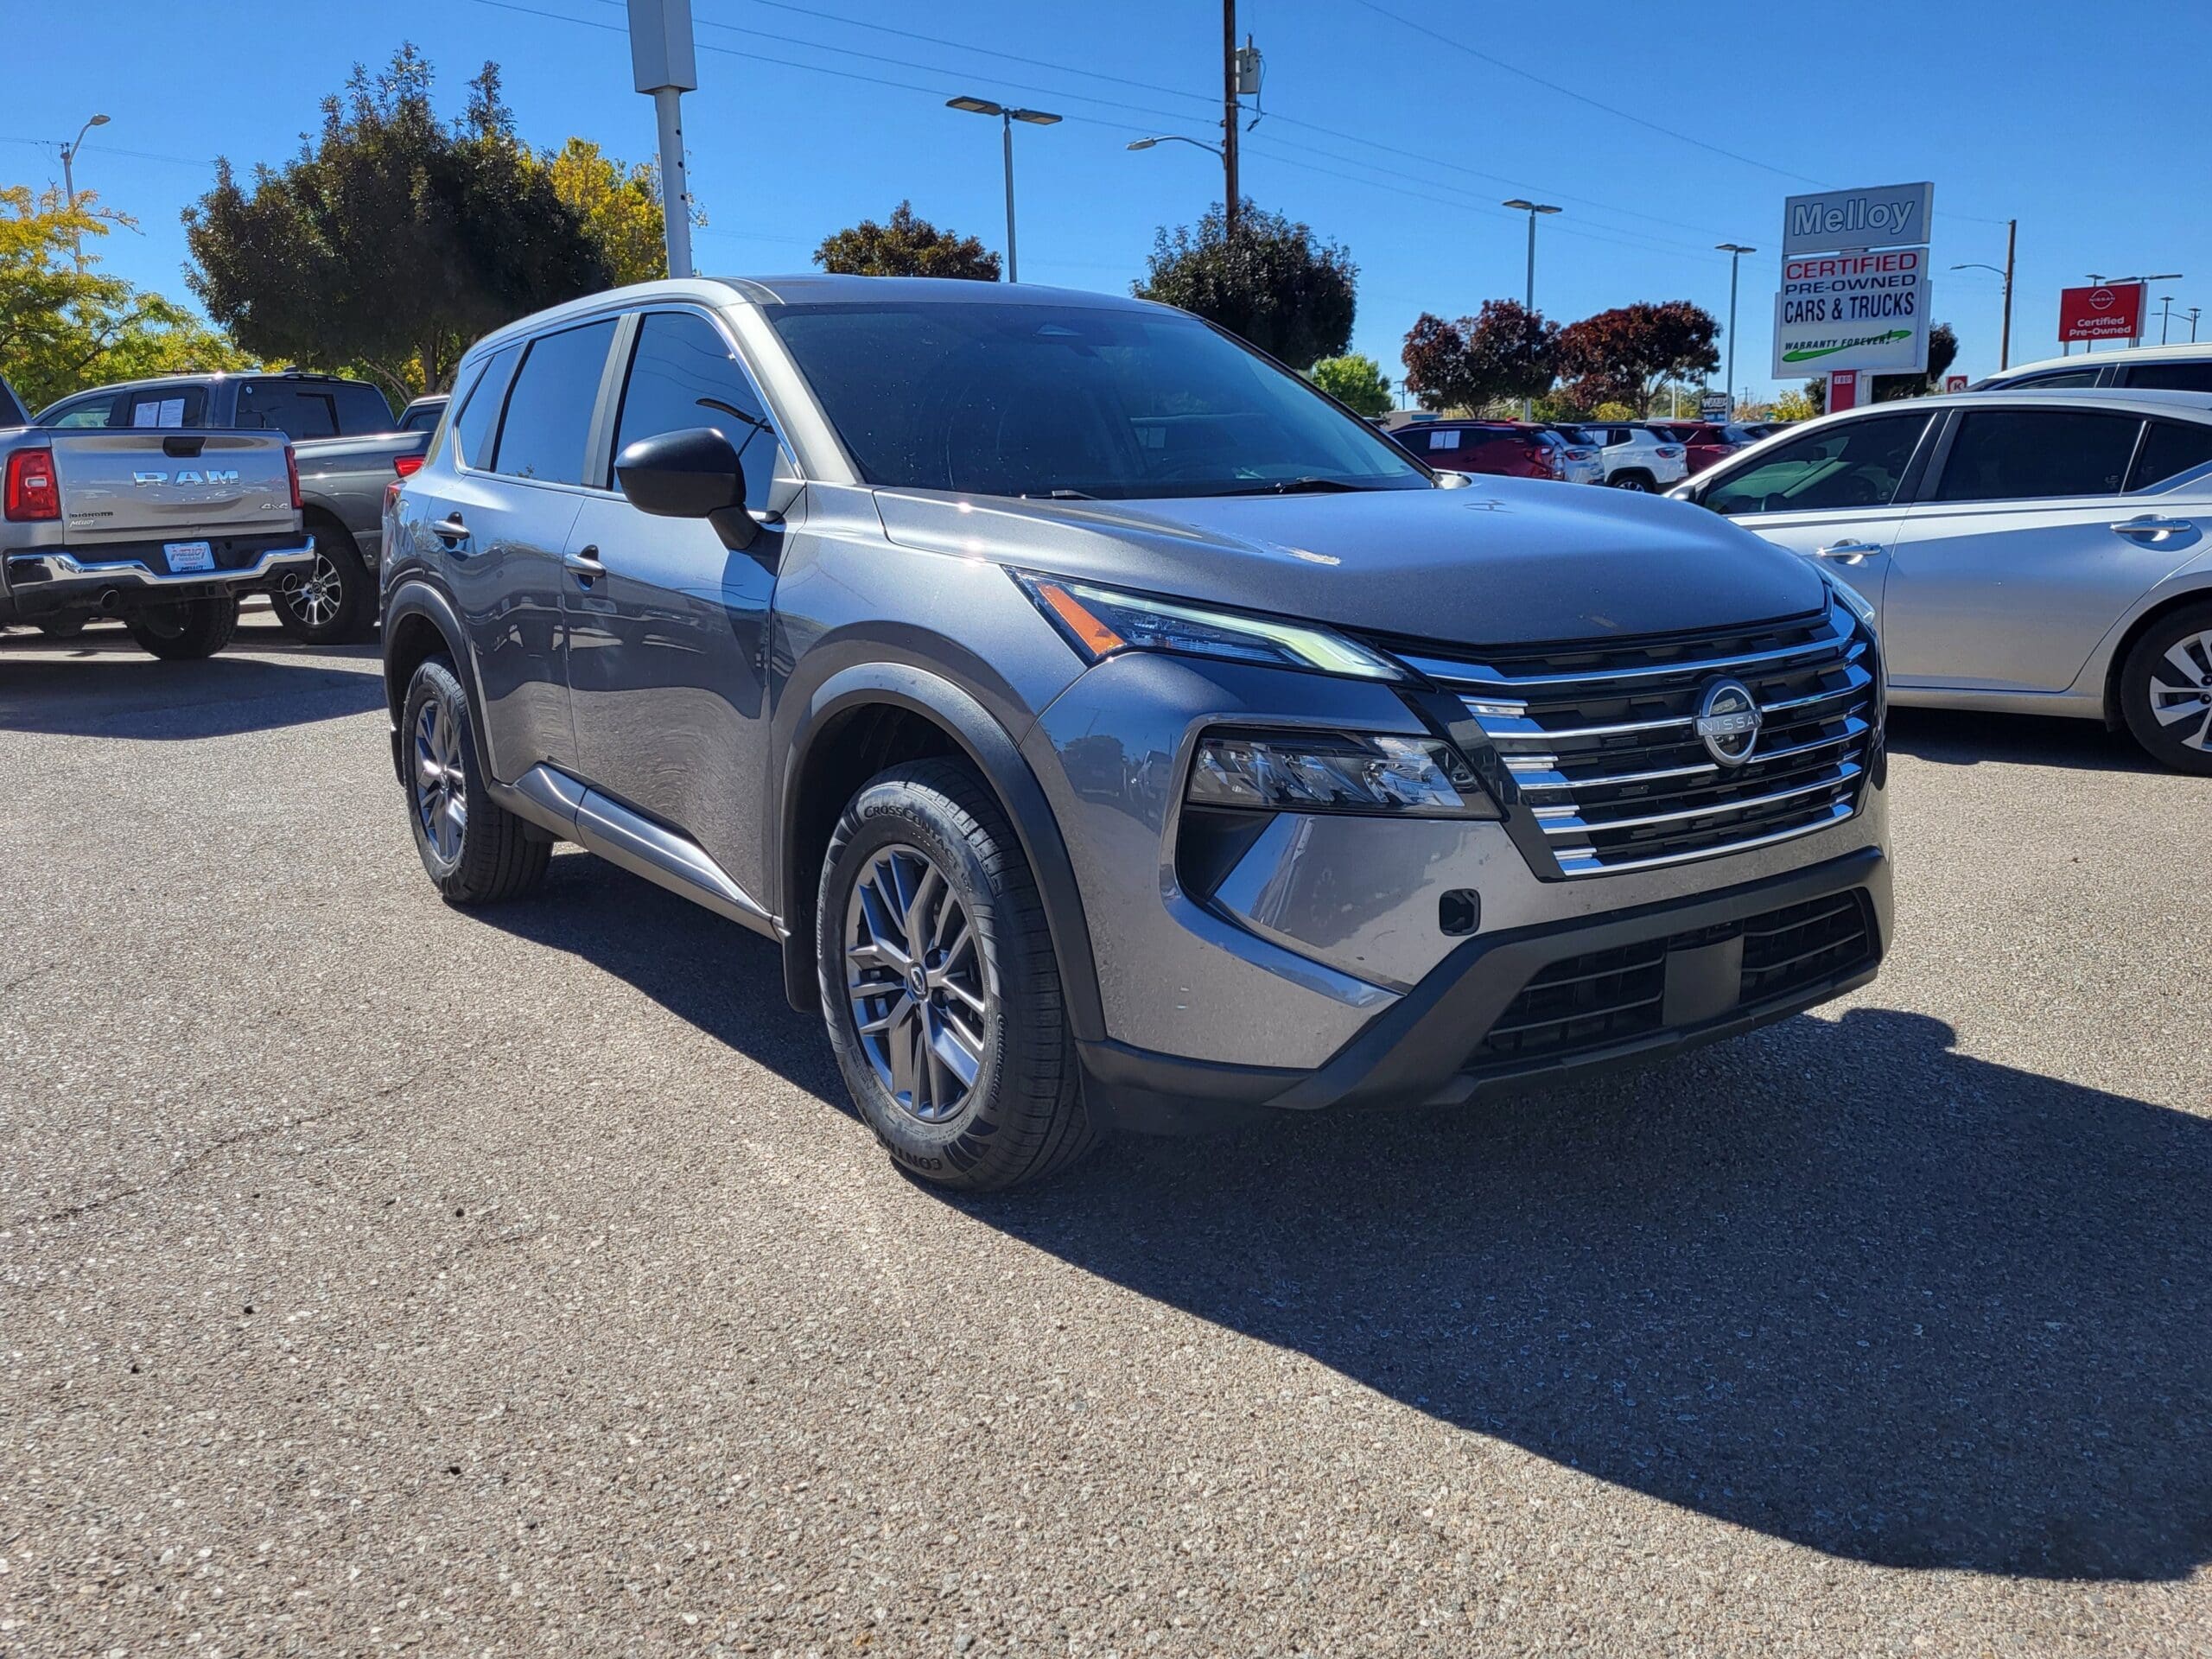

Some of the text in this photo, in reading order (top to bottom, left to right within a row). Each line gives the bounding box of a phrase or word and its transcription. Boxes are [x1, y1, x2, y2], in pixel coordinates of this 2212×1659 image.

[1793, 199, 1915, 236] Melloy
[1786, 253, 1917, 280] CERTIFIED
[1785, 274, 1916, 296] PRE-OWNED
[1784, 292, 1914, 324] CARS & TRUCKS
[2069, 325, 2132, 337] Pre-Owned
[2077, 316, 2125, 327] Certified
[1784, 329, 1892, 350] WARRANTY FOREVER!
[133, 469, 239, 488] RAM
[1700, 713, 1762, 733] NISSAN
